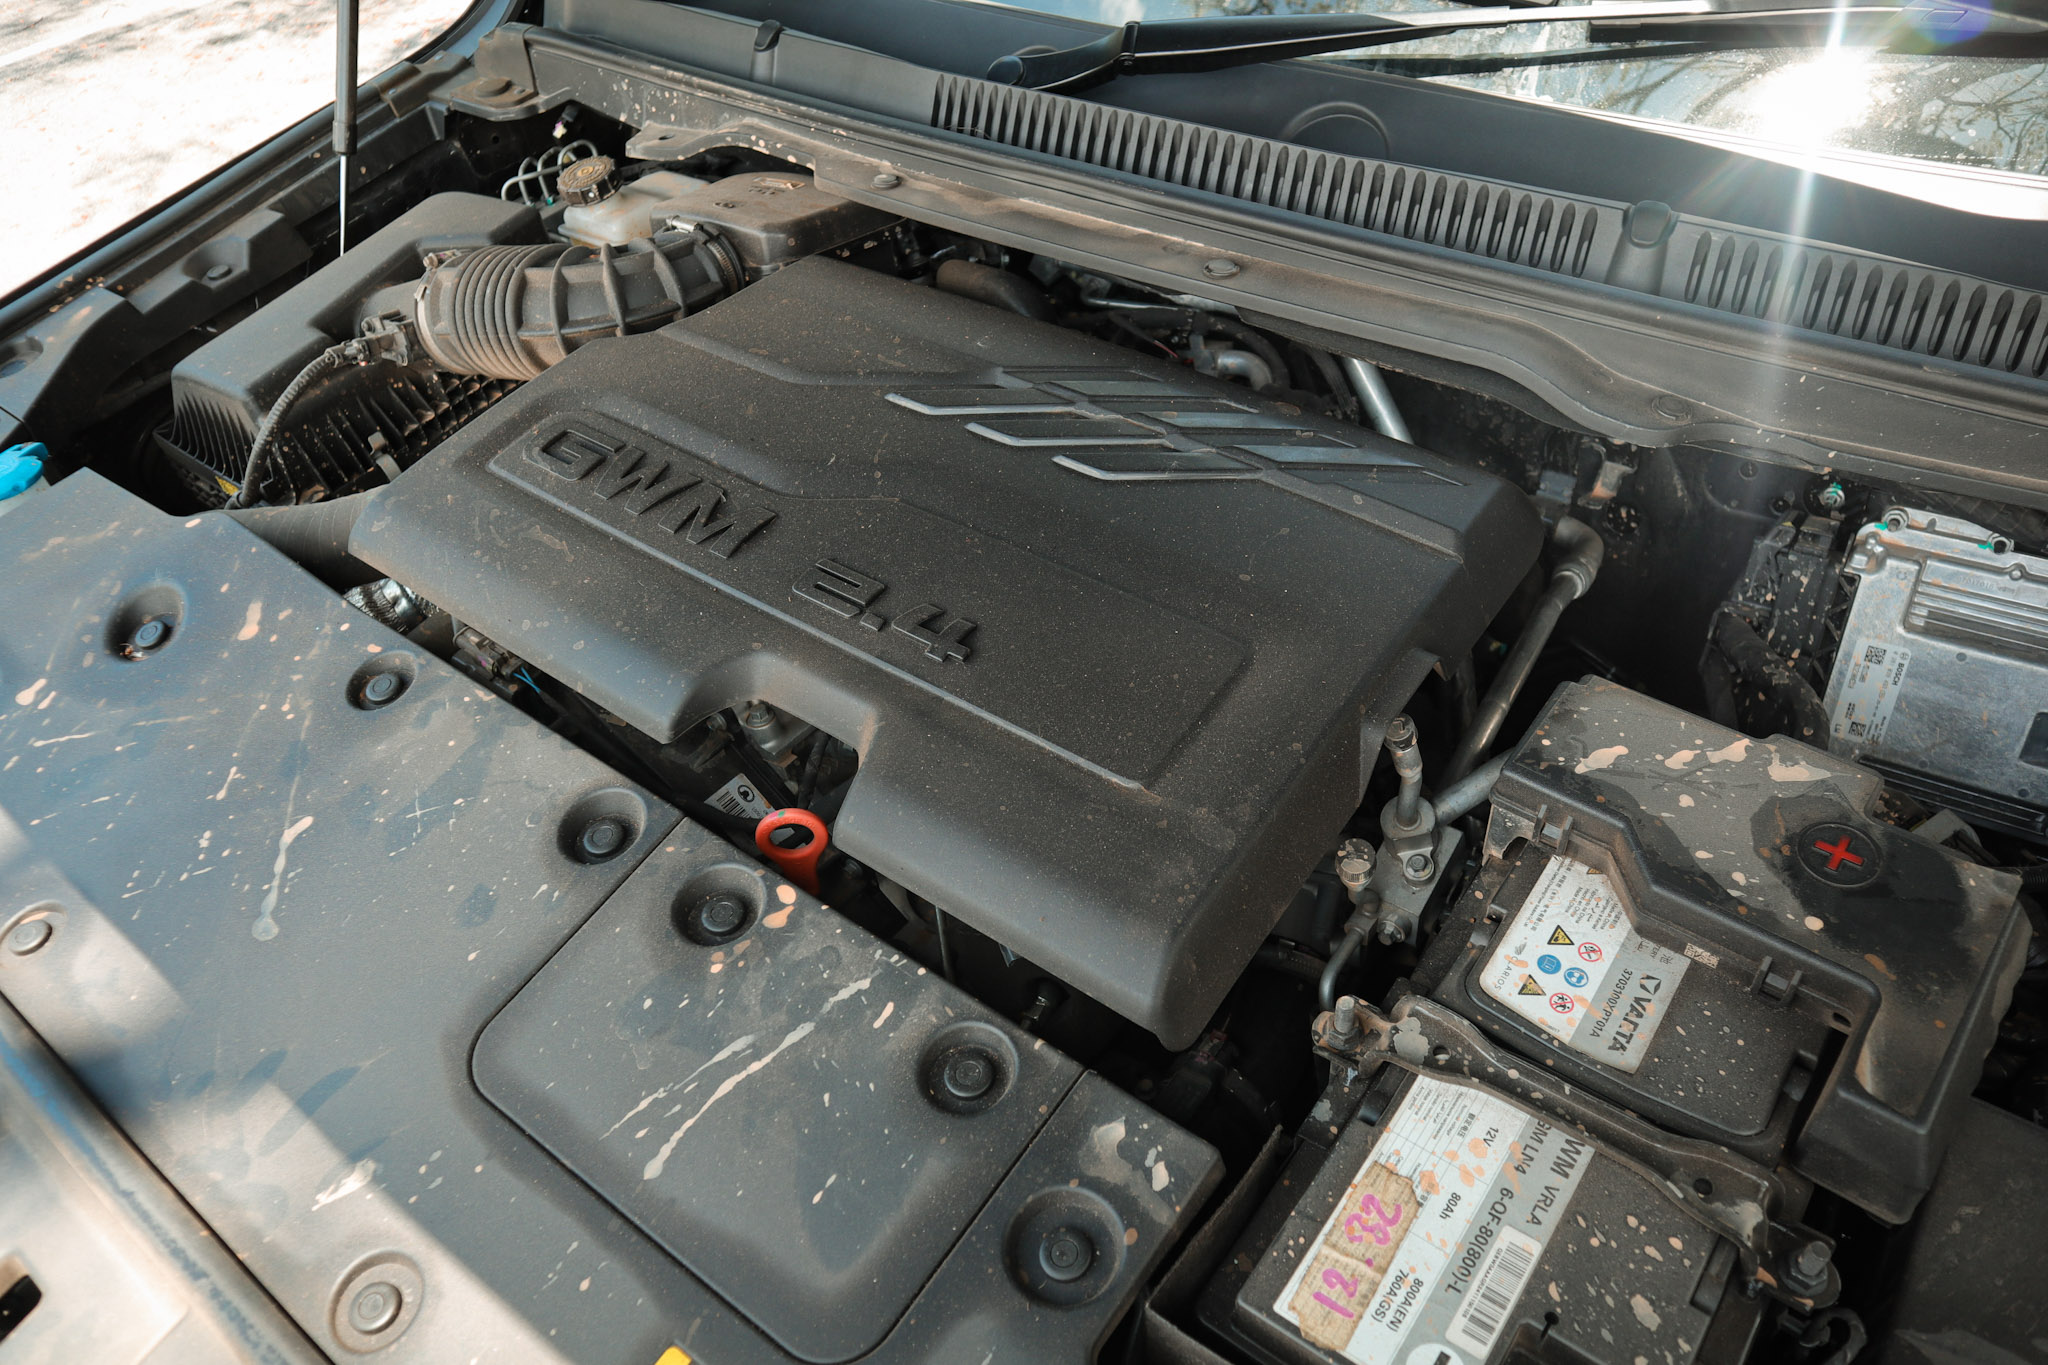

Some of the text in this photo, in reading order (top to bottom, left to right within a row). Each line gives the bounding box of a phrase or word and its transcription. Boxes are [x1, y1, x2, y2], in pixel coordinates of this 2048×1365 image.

[522, 426, 777, 558] GWM
[792, 558, 977, 662] 2.4
[1890, 661, 1905, 687] BOSCH
[1599, 917, 1610, 931] China
[1587, 966, 1634, 1040] 3703100XPT01A
[1605, 990, 1653, 1058] VARTA
[1480, 1123, 1500, 1148] 12V
[1511, 1142, 1539, 1177] LN4
[1437, 1190, 1463, 1222] 80Ah
[1524, 1181, 1561, 1230] VRLA
[1441, 1183, 1517, 1300] 6-QF-80(800)-L
[1368, 1265, 1410, 1325] 760A(GS)
[1383, 1274, 1425, 1334] 800A(EN)
